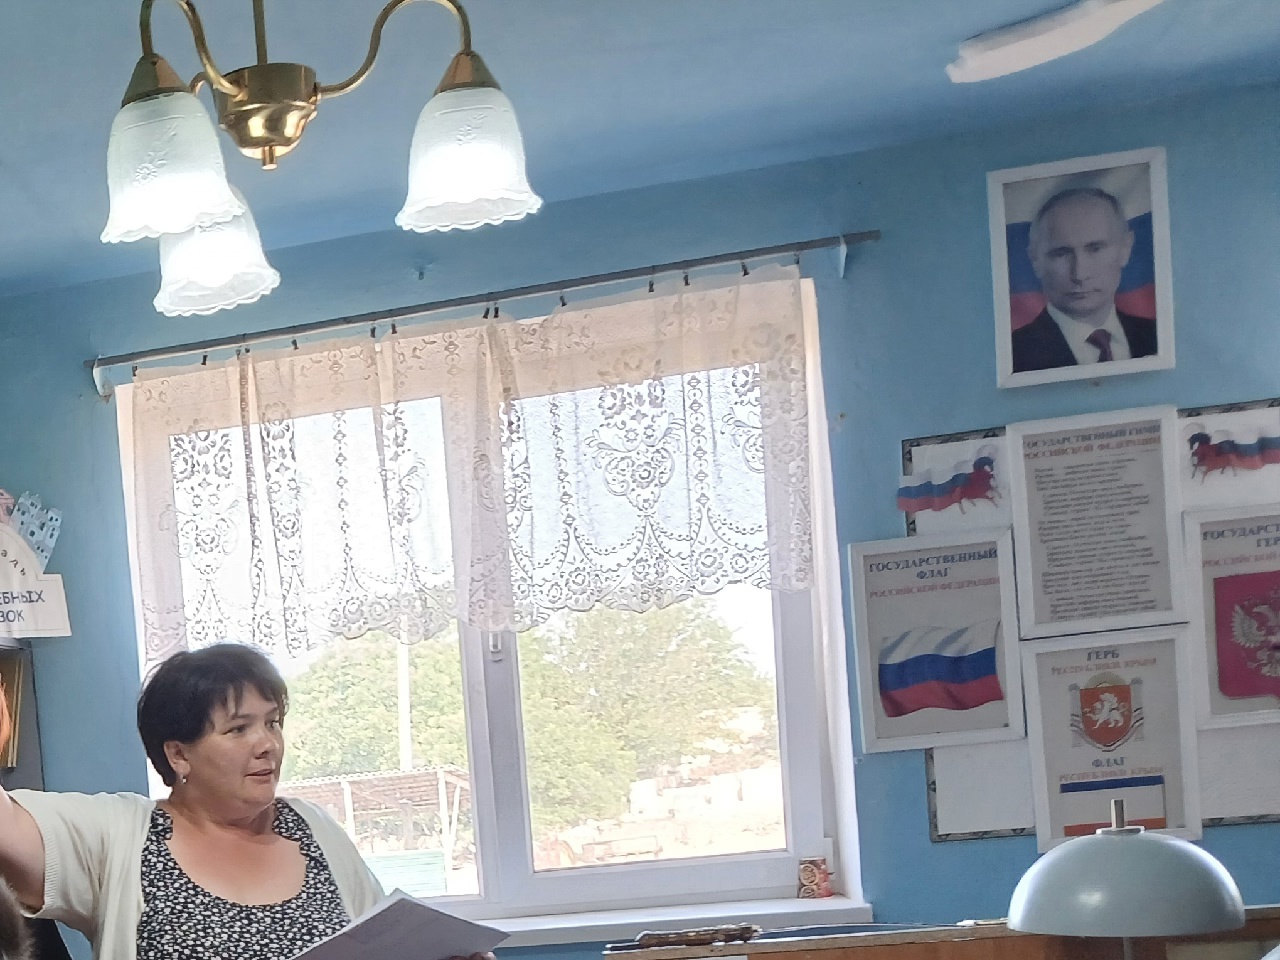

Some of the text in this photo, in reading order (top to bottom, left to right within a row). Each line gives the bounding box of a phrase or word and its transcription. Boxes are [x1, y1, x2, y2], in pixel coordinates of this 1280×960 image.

[870, 548, 997, 573] ГОСУДАРСТВЕННЫЙ
[916, 566, 951, 580] ФЛАГ
[1086, 649, 1120, 662] ГЕРБ
[1091, 756, 1127, 768] ФЛАГ
